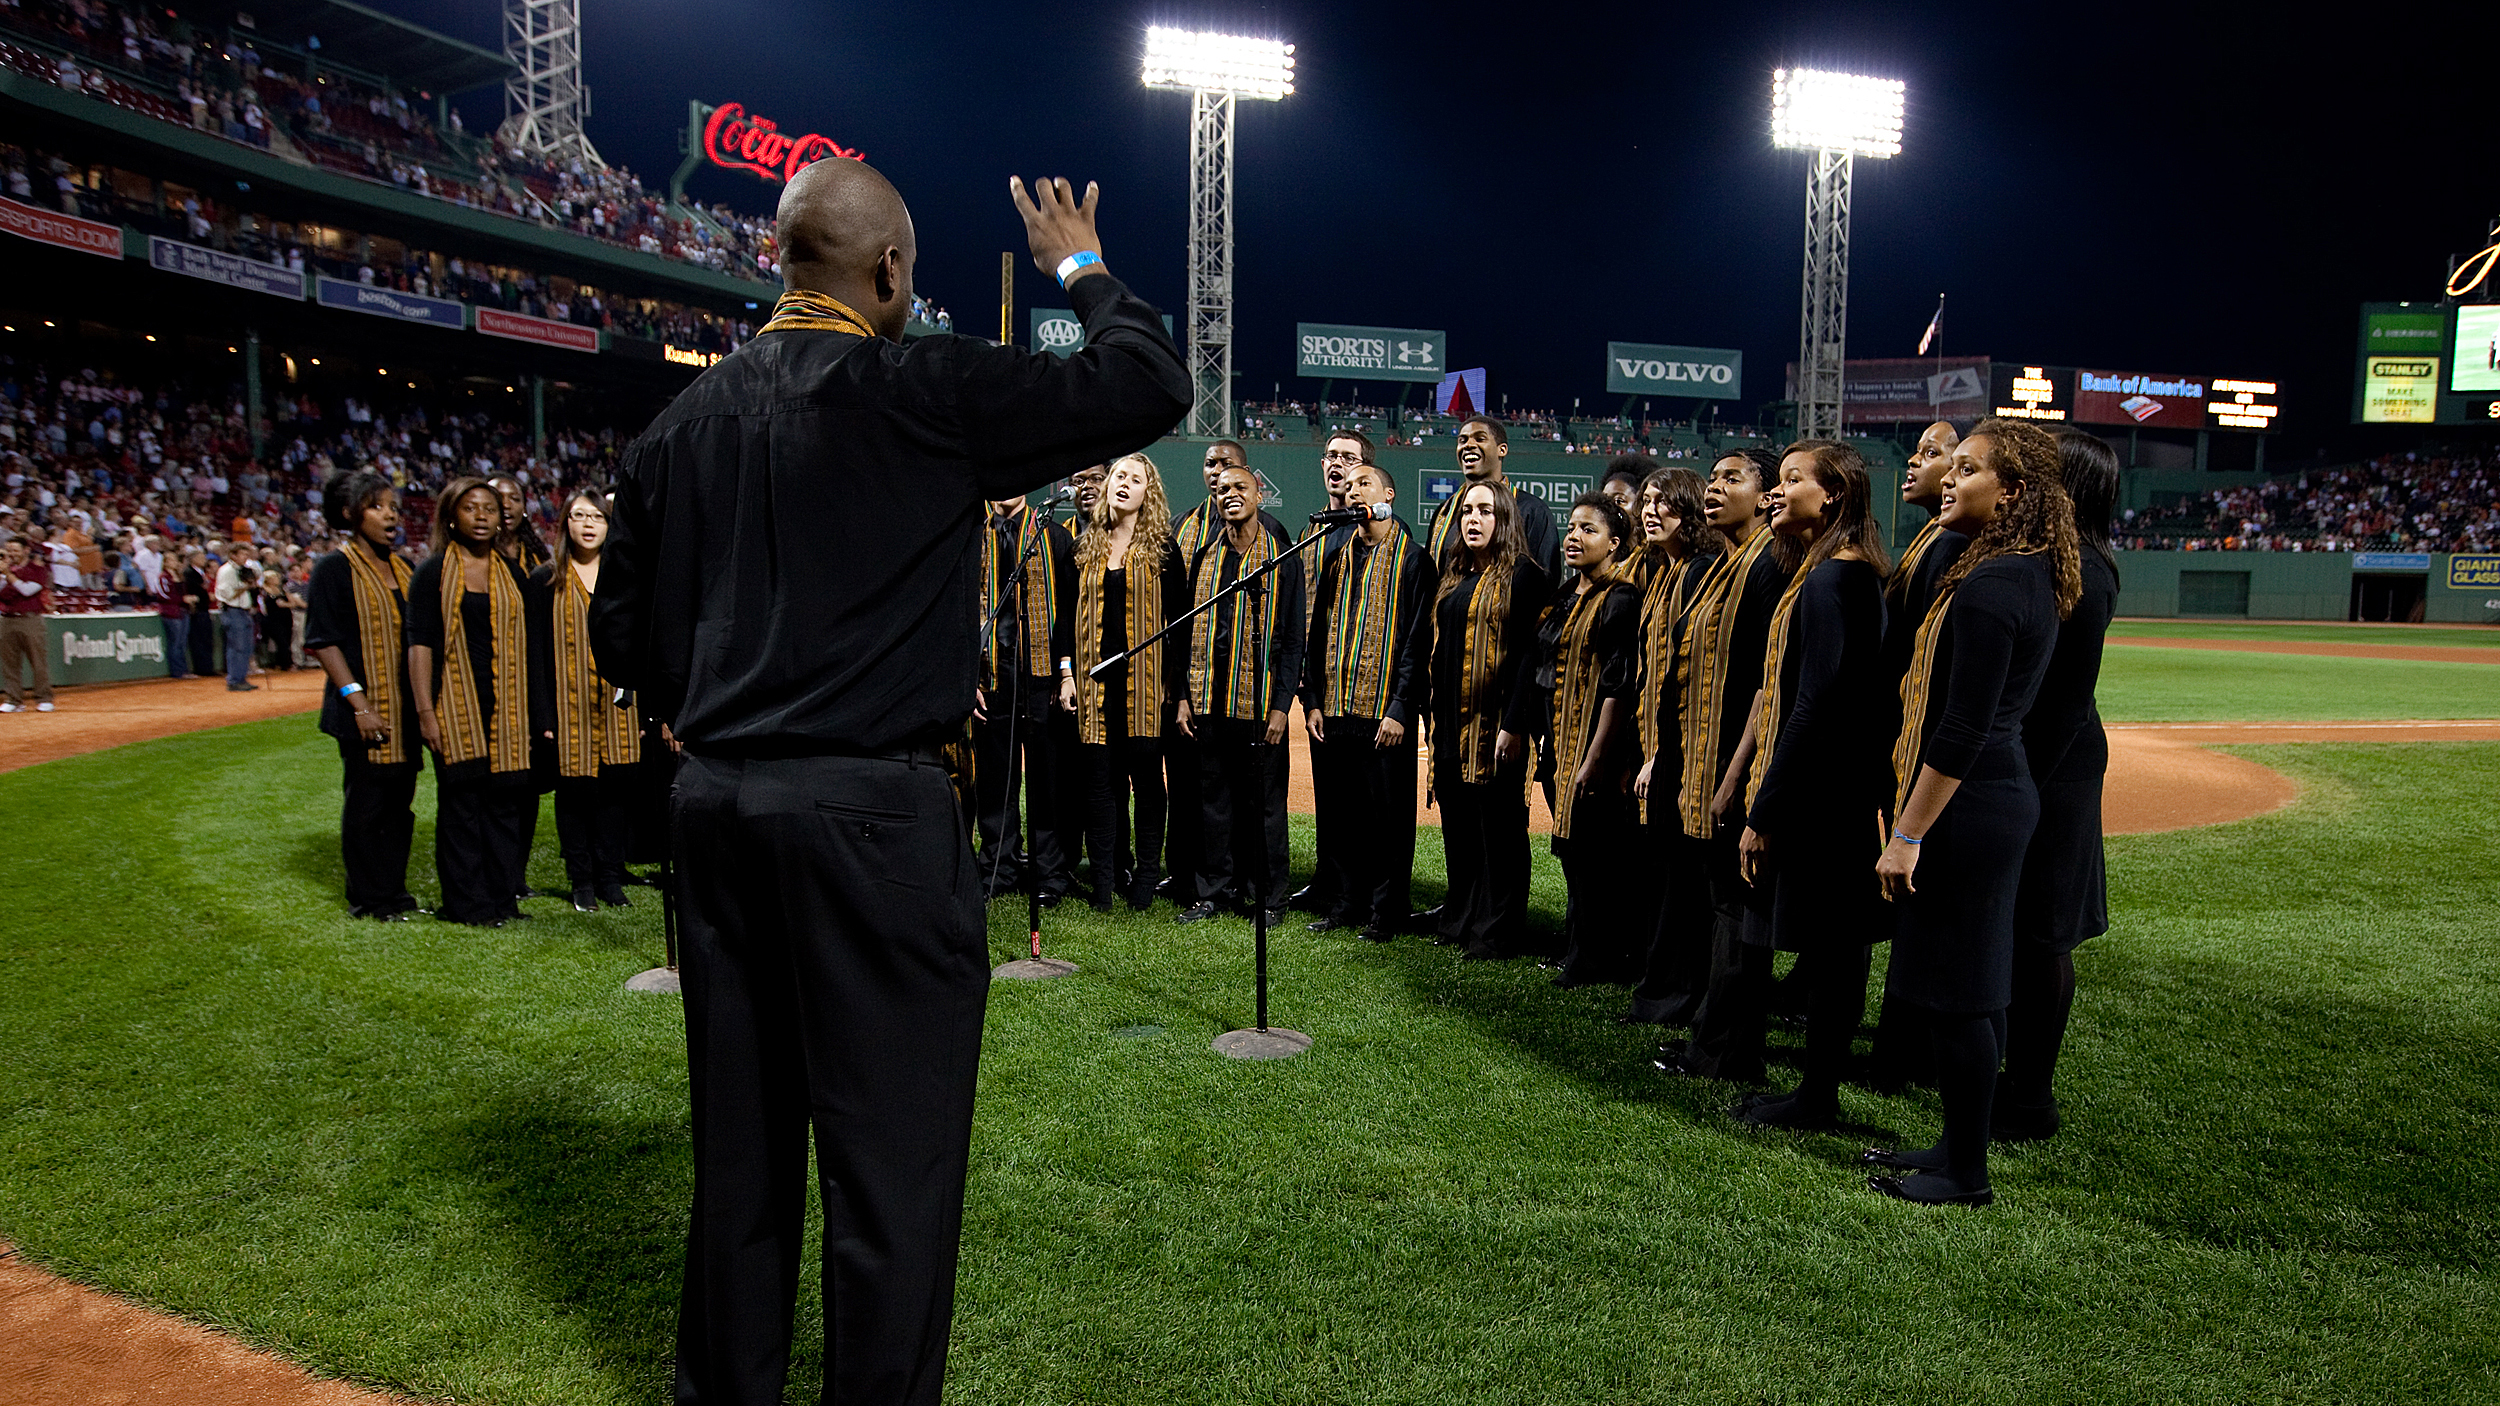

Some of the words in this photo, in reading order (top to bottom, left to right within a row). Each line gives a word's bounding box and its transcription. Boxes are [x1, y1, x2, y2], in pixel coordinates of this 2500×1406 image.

[483, 314, 545, 336] Northeastern
[547, 327, 594, 346] University
[1042, 320, 1076, 344] AAA
[664, 343, 707, 368] Kuumba
[1302, 335, 1385, 357] SPORTS
[1302, 354, 1385, 368] AUTHORITY
[1615, 358, 1733, 384] VOLVO
[2375, 364, 2430, 376] STANLEY
[2081, 372, 2121, 392] Bank
[2121, 375, 2140, 394] of
[2139, 376, 2203, 397] America
[2452, 572, 2500, 583] GLASS
[2454, 559, 2500, 572] GIANT
[63, 631, 115, 665] Poland
[116, 630, 164, 662] Spring
